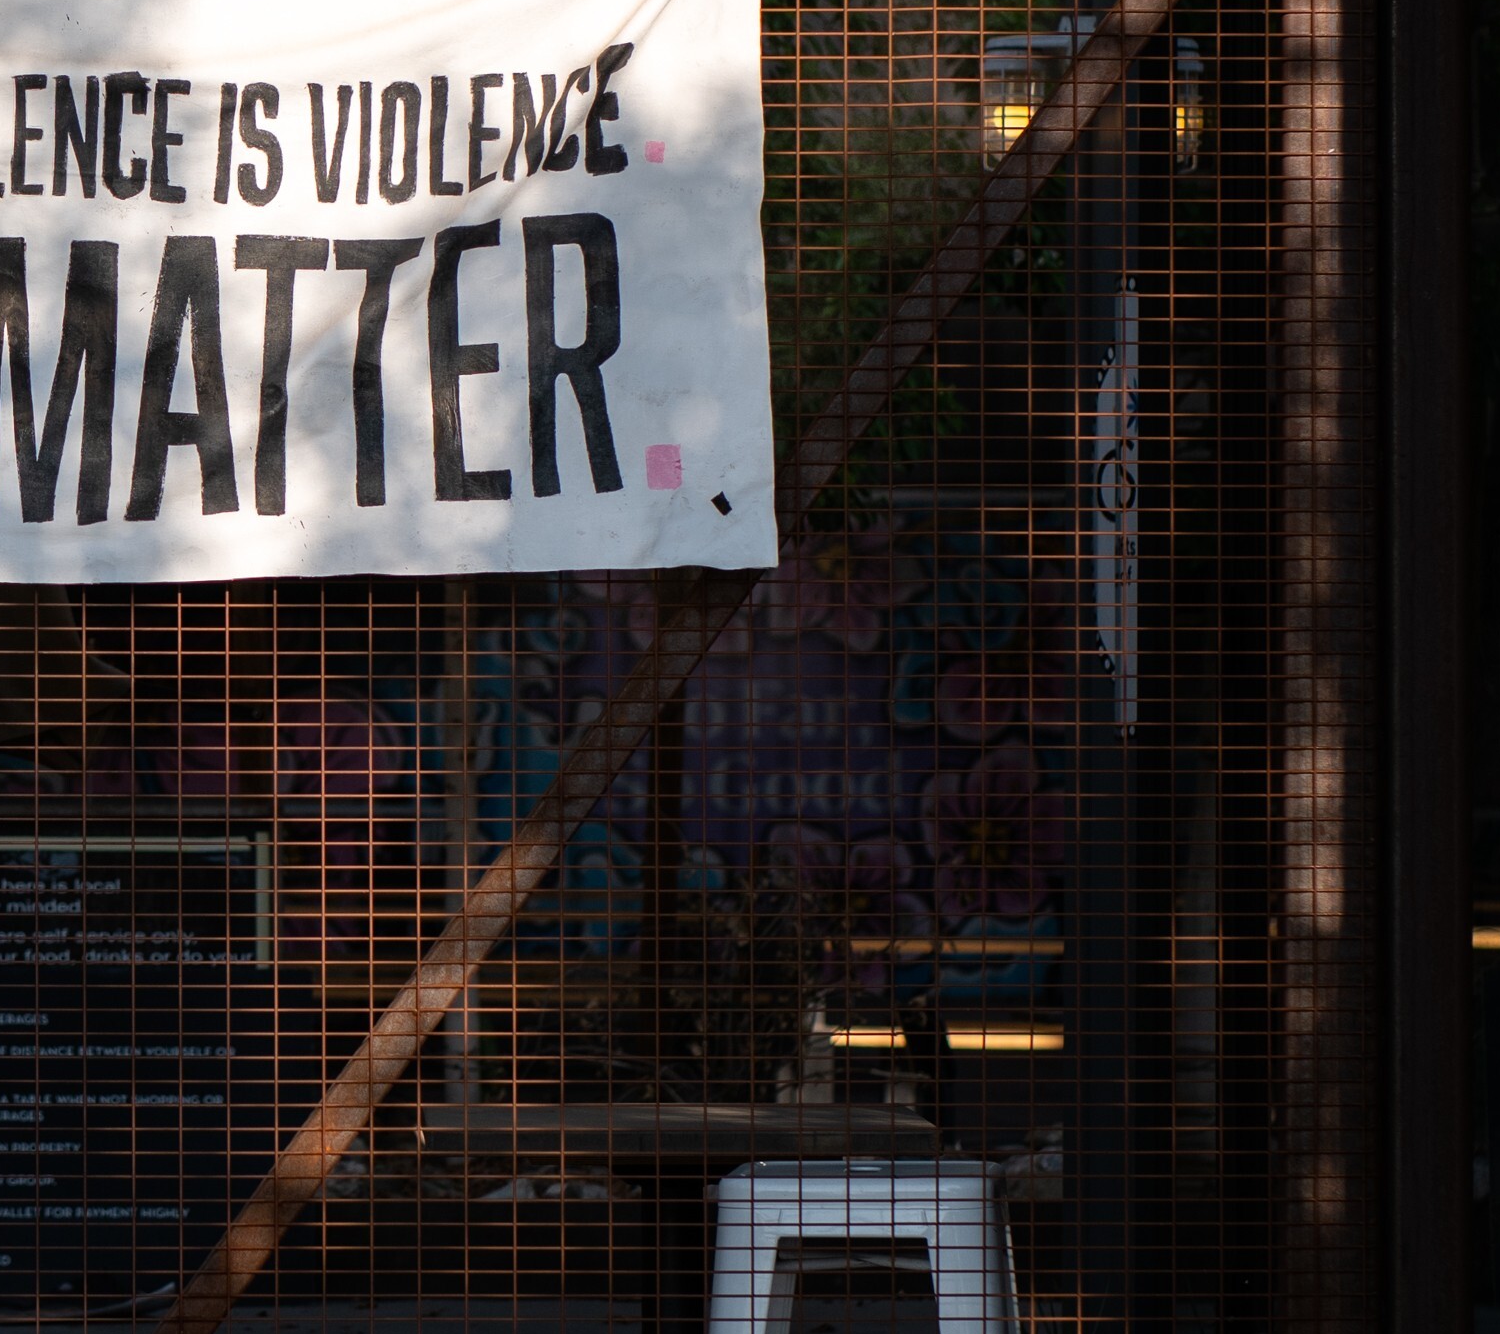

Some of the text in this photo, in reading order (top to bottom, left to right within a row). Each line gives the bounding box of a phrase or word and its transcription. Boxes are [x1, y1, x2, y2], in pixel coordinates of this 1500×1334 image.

[212, 81, 284, 206] IS
[707, 749, 901, 817] Good
[1, 877, 46, 895] here
[51, 878, 69, 895] is
[73, 877, 122, 895] local
[5, 898, 83, 914] minded
[31, 927, 70, 945] self
[74, 928, 147, 945] service
[82, 948, 145, 966] drinks
[149, 951, 172, 966] or
[177, 948, 204, 966] do
[208, 951, 256, 969] your
[9, 1045, 75, 1057] DISTANCE
[78, 1045, 143, 1057] BETWEEN
[0, 1093, 10, 1104] A
[11, 1093, 53, 1104] TABLE
[55, 1093, 97, 1104] WHEN
[99, 1093, 130, 1104] NOT
[131, 1094, 200, 1104] SHOPPING
[202, 1094, 225, 1105] OR
[10, 1141, 82, 1153] PROPERTY
[44, 1206, 74, 1219] FOR
[75, 1206, 139, 1219] PAYMENT
[139, 1206, 191, 1219] HIGHLY
